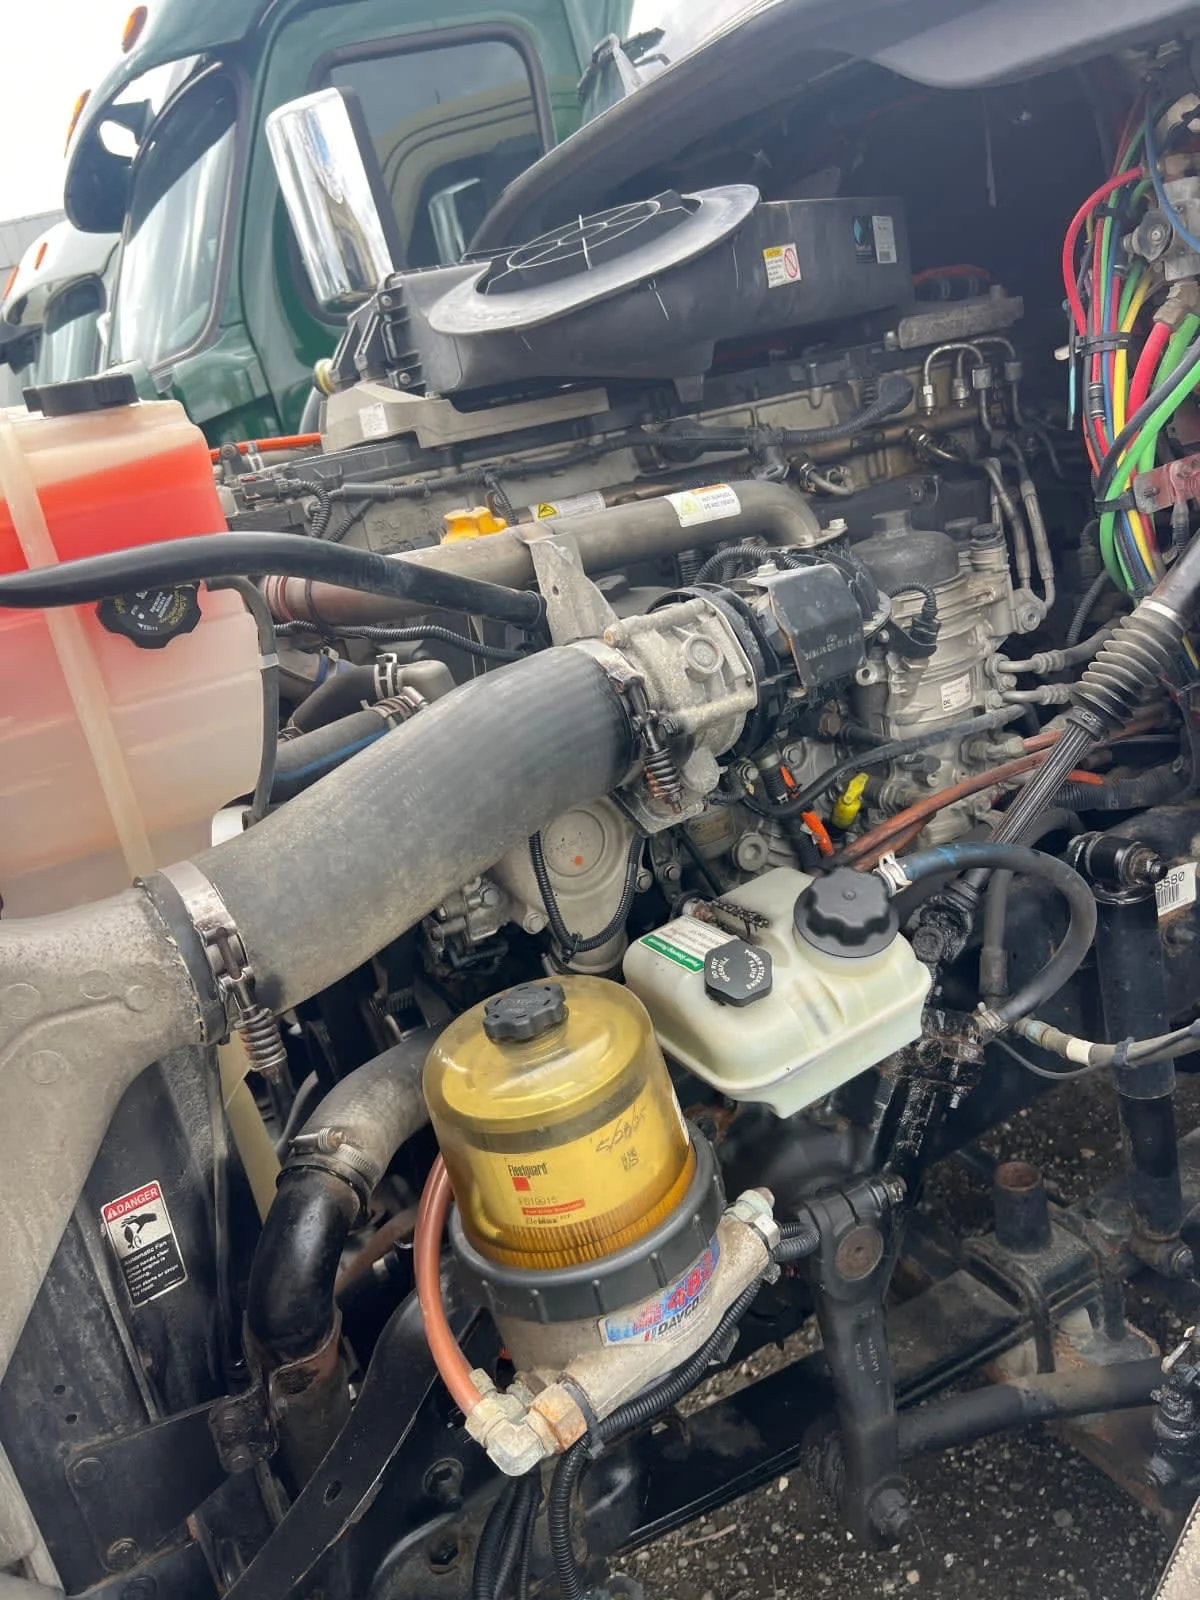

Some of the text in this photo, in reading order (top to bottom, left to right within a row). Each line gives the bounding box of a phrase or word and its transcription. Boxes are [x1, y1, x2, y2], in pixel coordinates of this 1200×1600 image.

[507, 1162, 548, 1178] Fleetguard
[116, 1187, 159, 1213] DANGER
[657, 1294, 700, 1336] DAVCO
